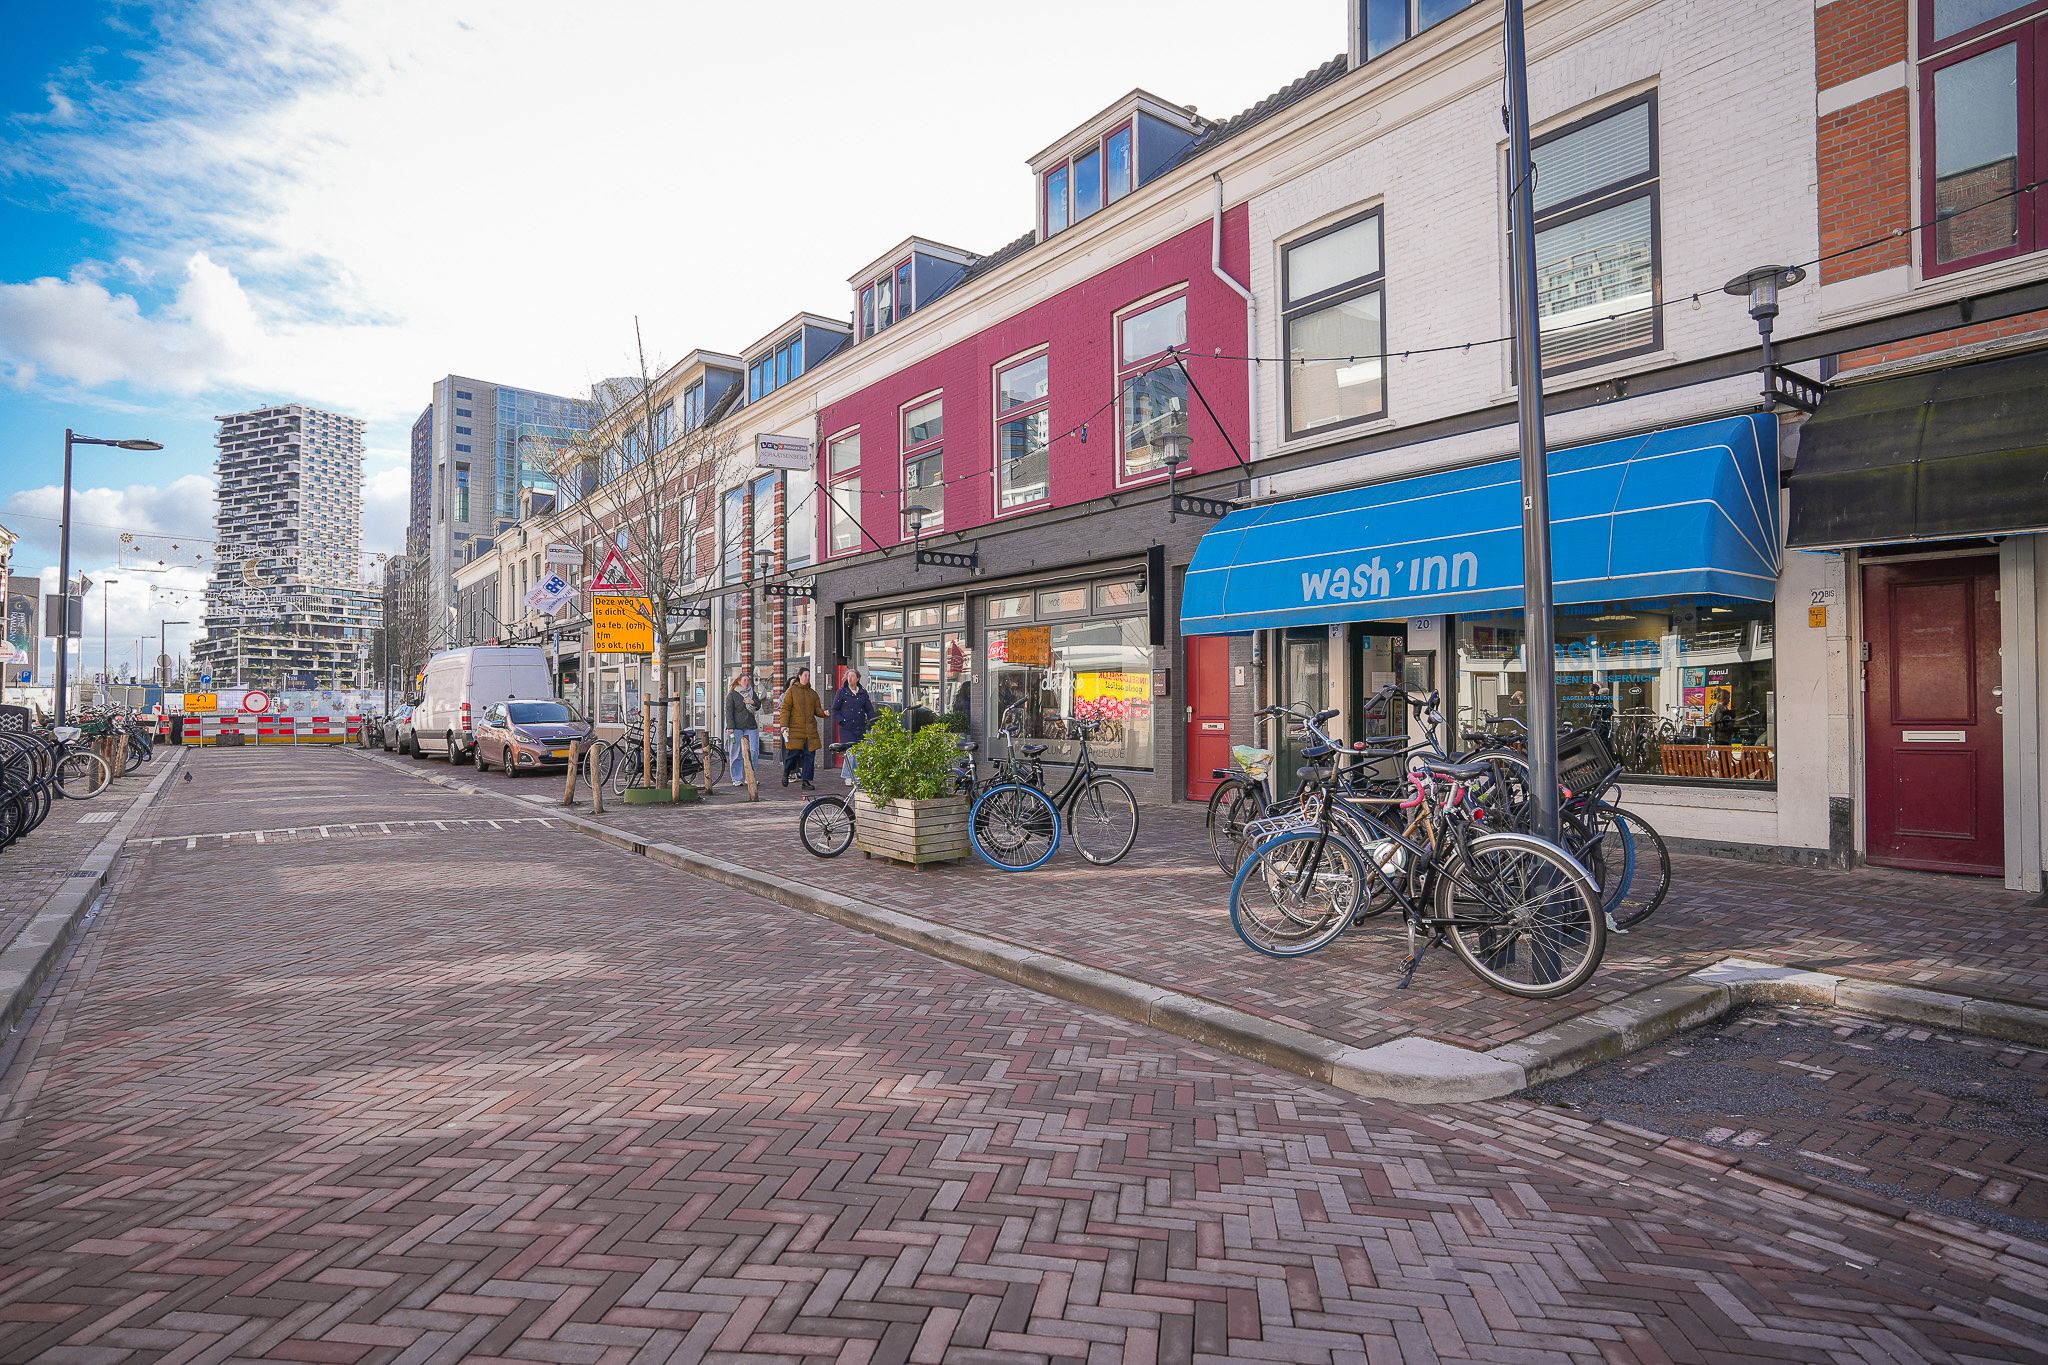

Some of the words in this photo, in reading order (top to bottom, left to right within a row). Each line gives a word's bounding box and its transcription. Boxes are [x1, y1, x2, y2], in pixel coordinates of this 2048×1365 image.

[1525, 497, 1531, 508] 4
[595, 597, 616, 606] Deze
[617, 599, 634, 607] weg
[595, 607, 603, 616] is
[604, 608, 626, 616] dicht
[608, 621, 624, 629] feb.
[625, 621, 646, 632] (07h)
[1417, 619, 1430, 630] 20
[596, 631, 611, 641] t/m
[596, 641, 606, 649] 05
[607, 641, 624, 649] okt.
[625, 641, 645, 651] (16h)
[972, 674, 979, 684] 16
[1087, 745, 1126, 759] ARBEQUE
